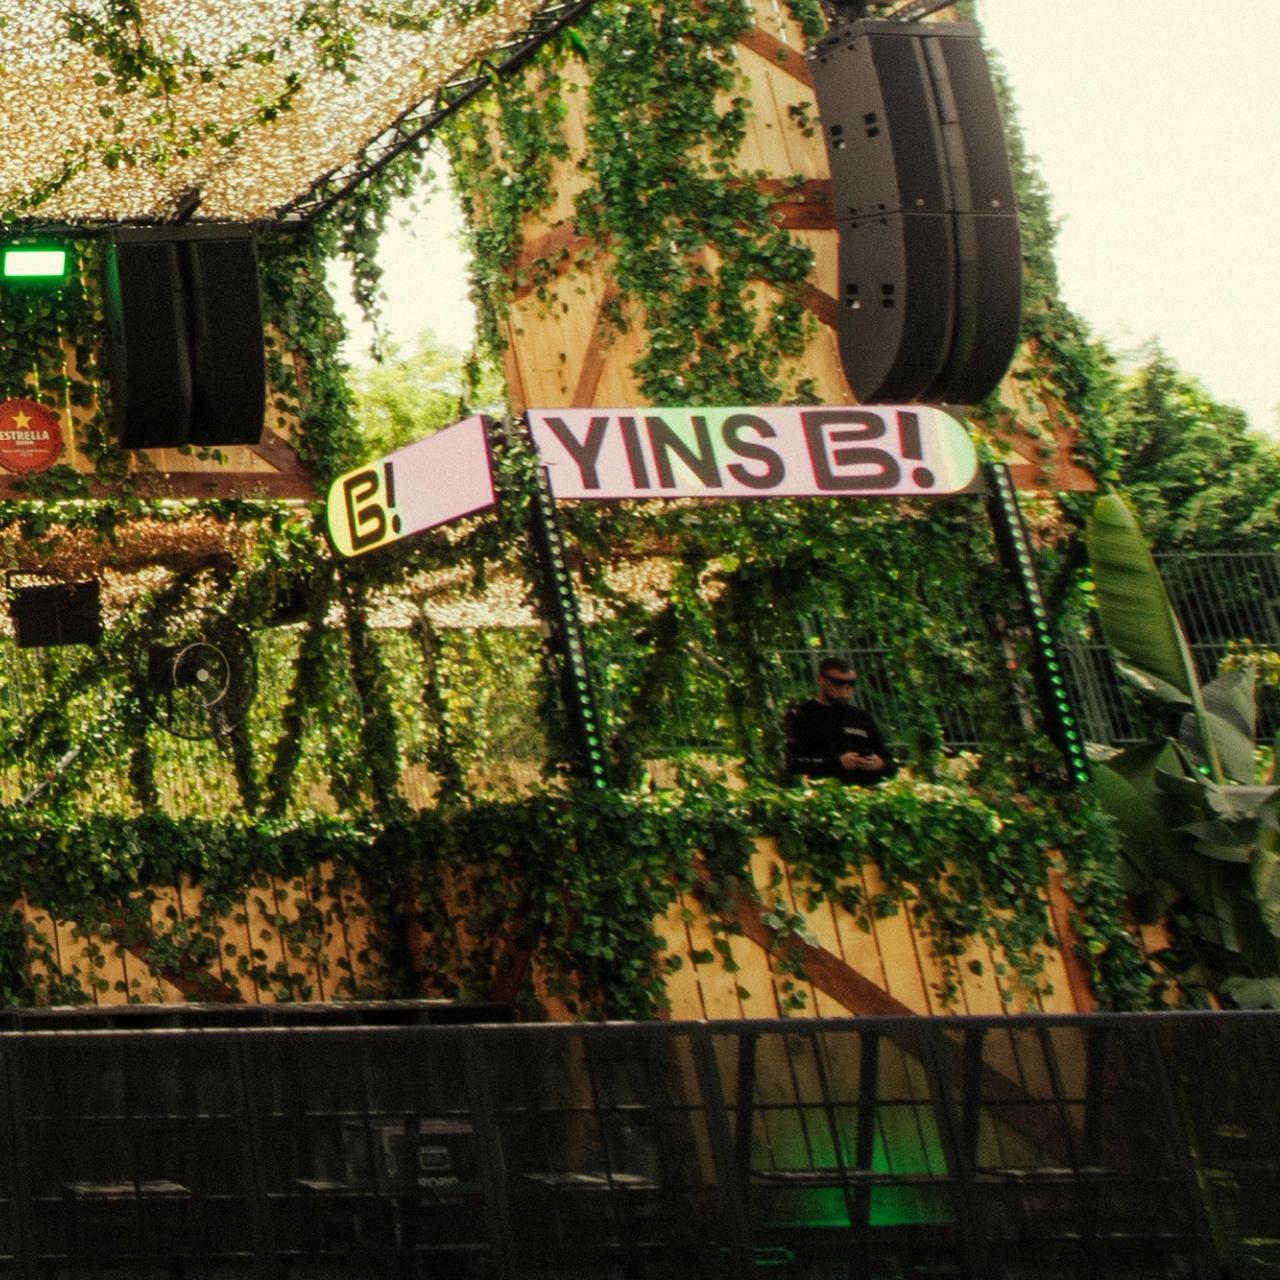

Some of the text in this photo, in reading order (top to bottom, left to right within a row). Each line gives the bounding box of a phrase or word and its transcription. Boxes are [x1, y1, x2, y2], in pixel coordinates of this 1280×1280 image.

[544, 410, 936, 491] YINS B!
[343, 462, 403, 551] B!
